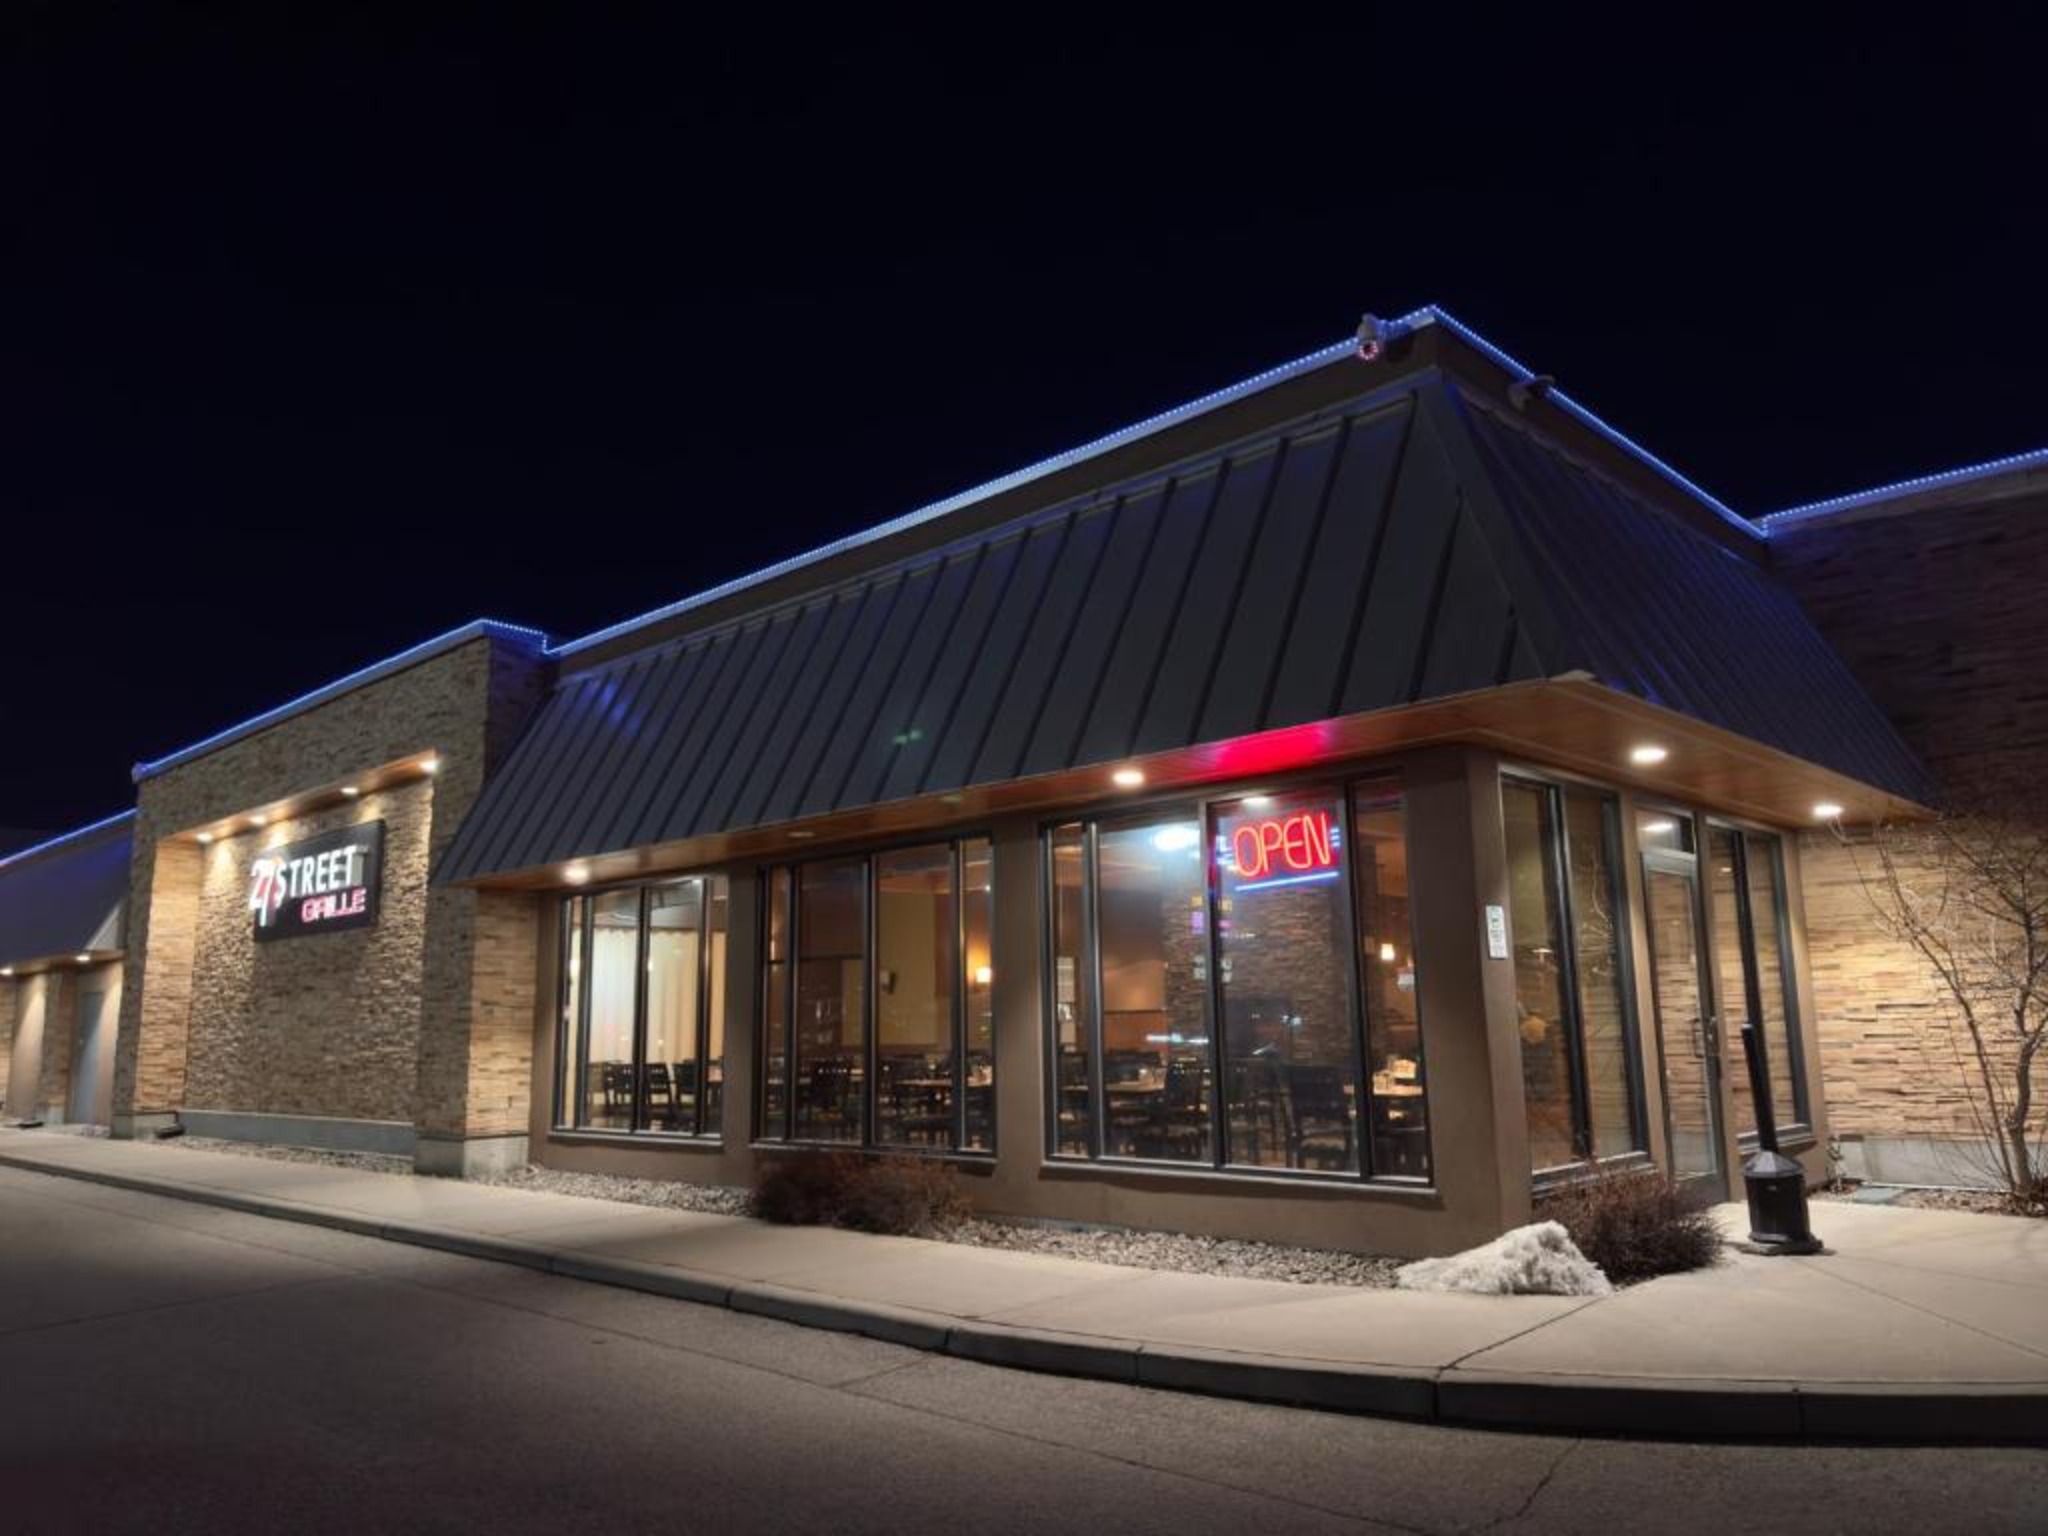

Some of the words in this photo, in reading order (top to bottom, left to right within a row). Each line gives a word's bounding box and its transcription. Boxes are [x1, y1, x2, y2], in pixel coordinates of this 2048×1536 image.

[1235, 812, 1331, 877] OPEN
[275, 845, 362, 909] STREET
[301, 887, 367, 923] GRILLE
